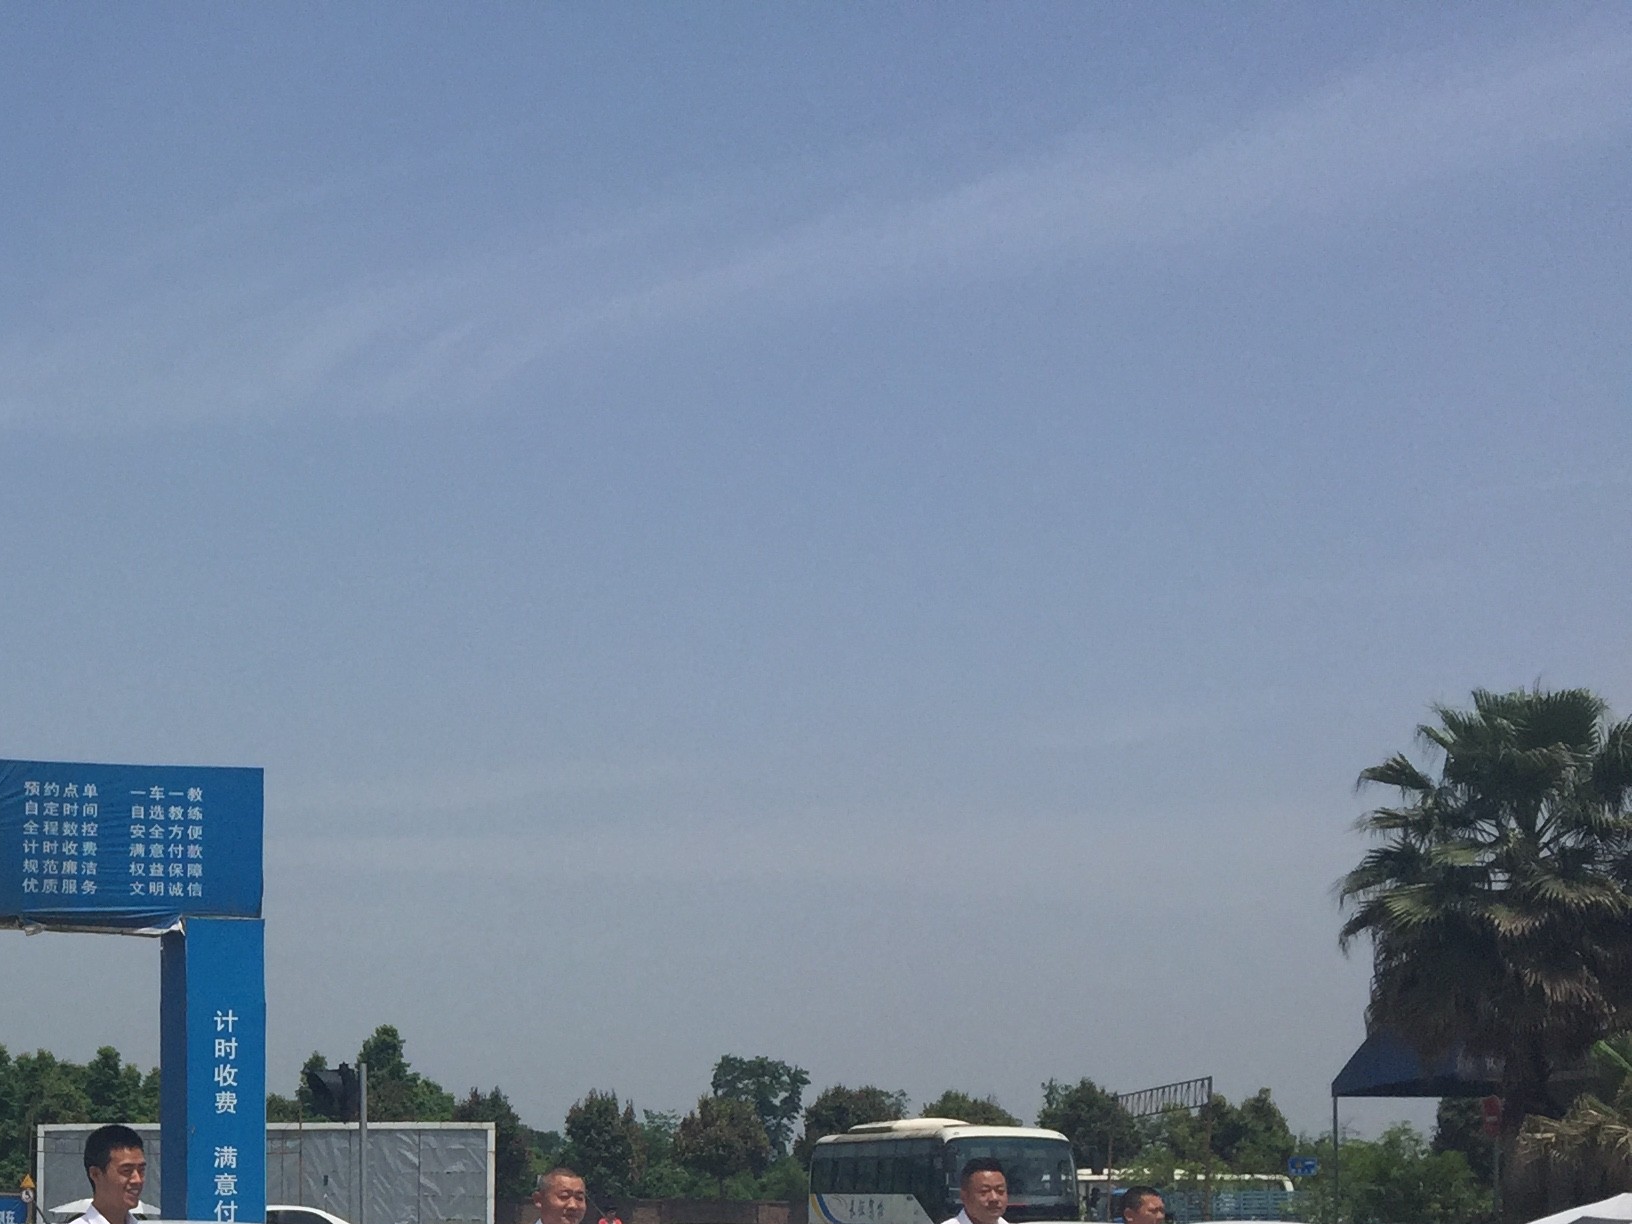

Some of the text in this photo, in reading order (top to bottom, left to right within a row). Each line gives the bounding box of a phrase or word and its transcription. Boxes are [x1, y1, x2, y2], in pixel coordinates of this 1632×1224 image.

[23, 781, 99, 798] 预约点单
[129, 786, 203, 802] 一车一教
[23, 801, 99, 817] 自定时间
[129, 805, 203, 821] 自选教练
[23, 820, 99, 837] 全程数控
[129, 824, 203, 841] 安全方便
[23, 840, 99, 857] 计时收费
[129, 843, 203, 859] 满意付款
[23, 859, 99, 876] 规范廉洁
[129, 862, 203, 878] 权益保障
[23, 879, 99, 896] 优质服务
[129, 881, 203, 898] 文明诚信
[214, 1010, 239, 1115] 计时收费
